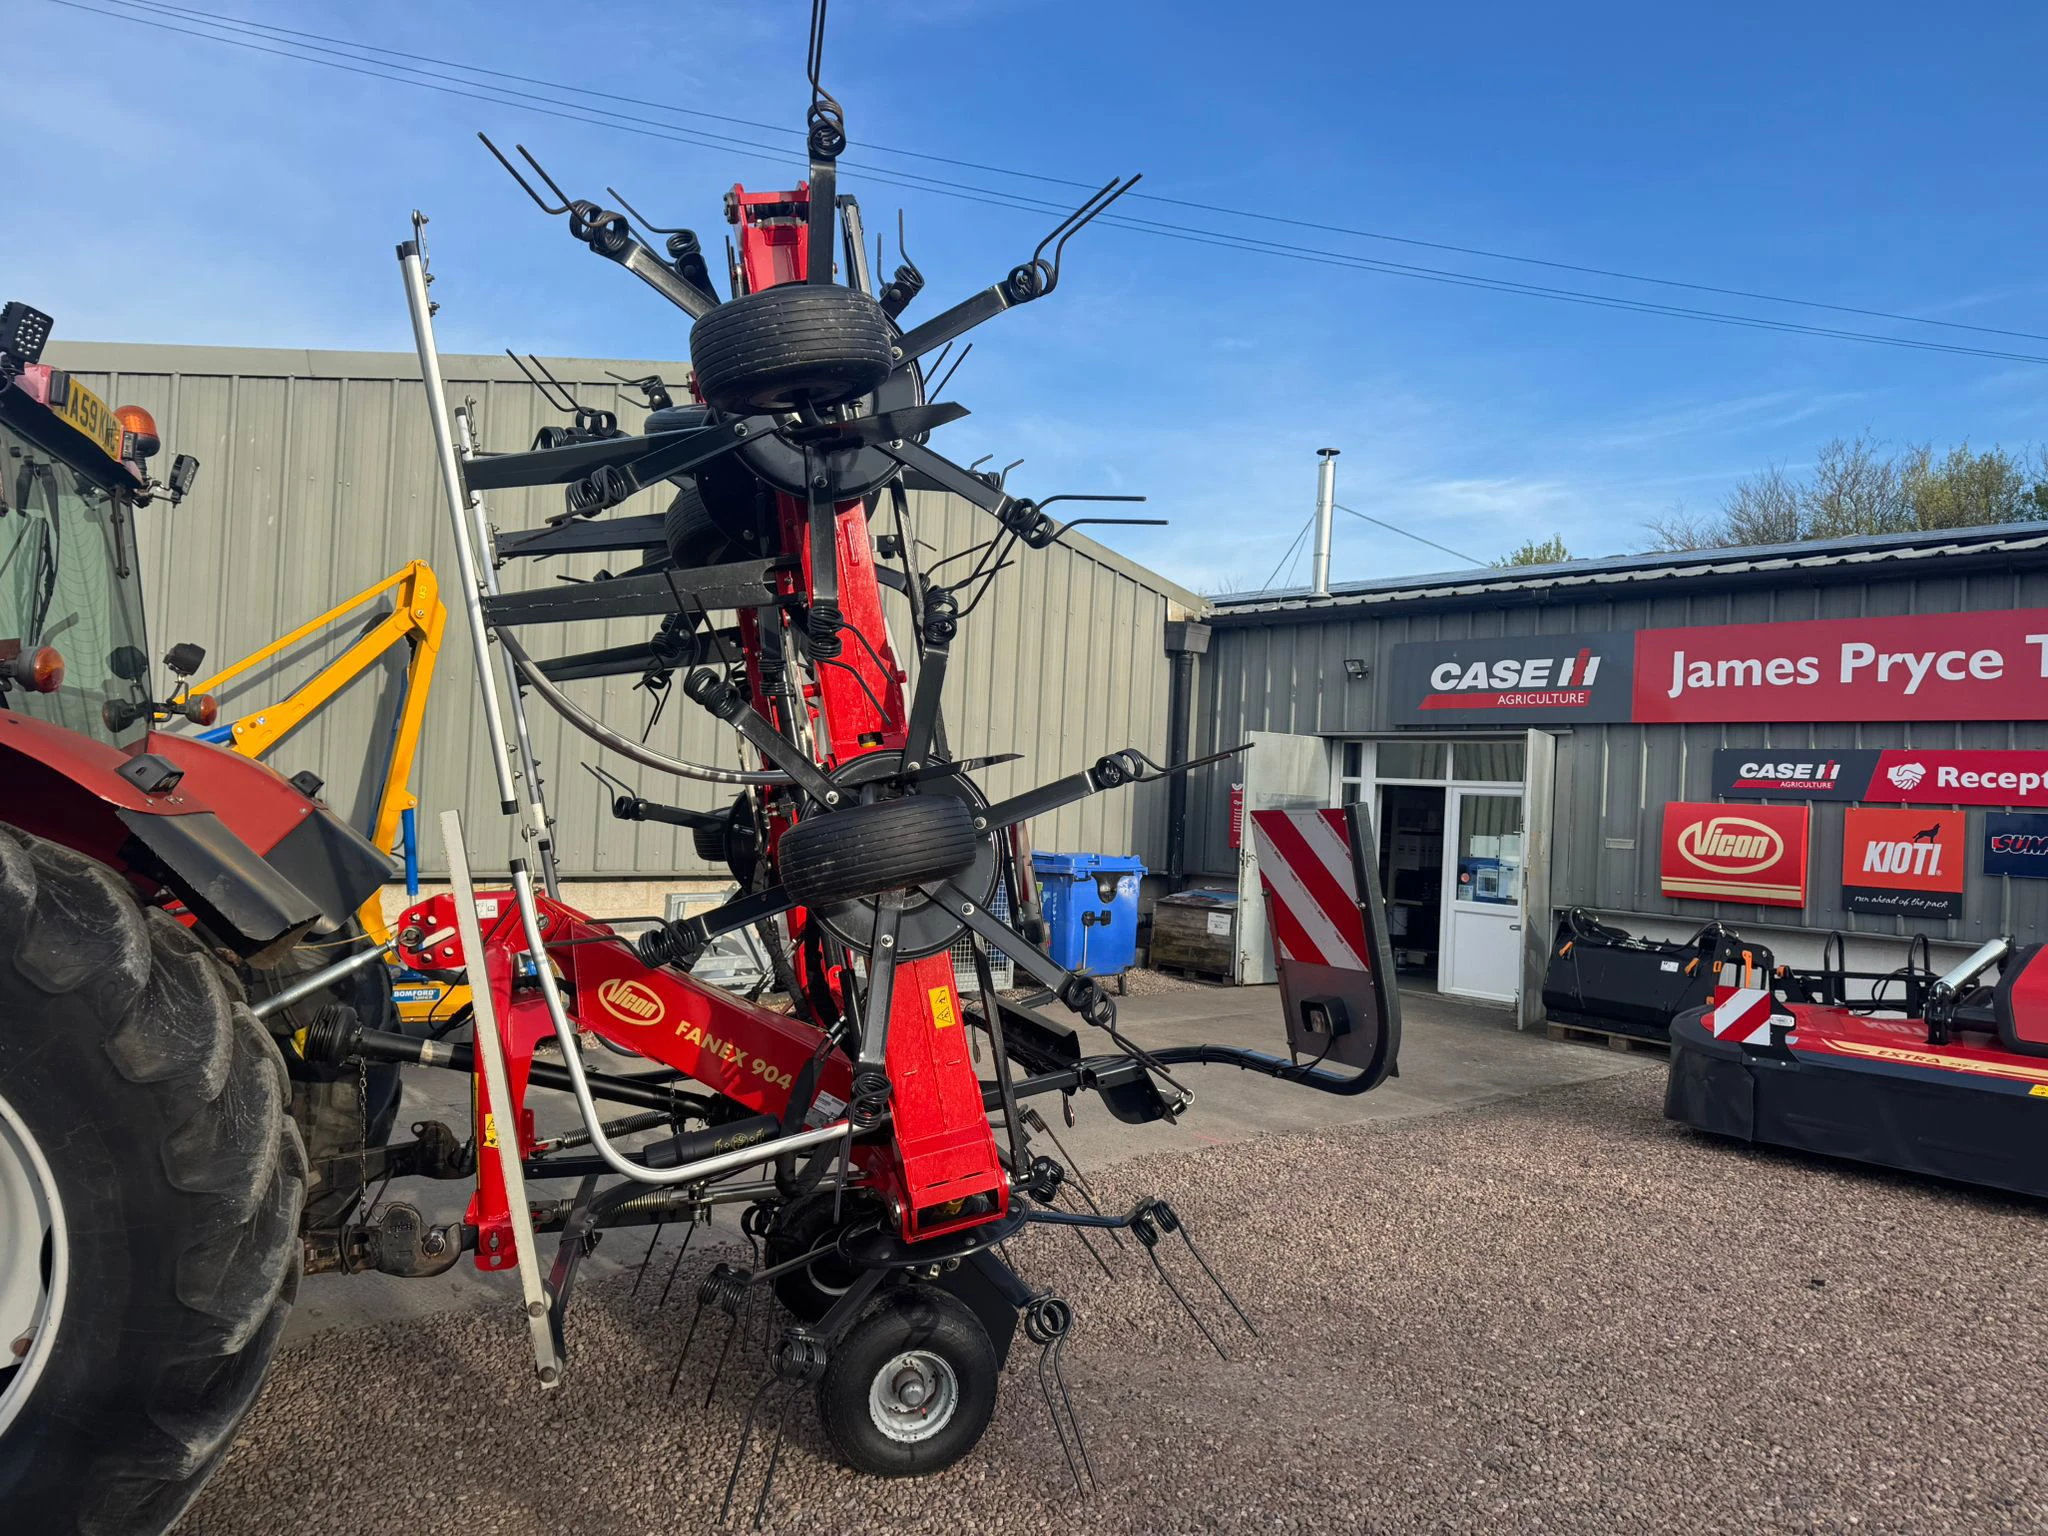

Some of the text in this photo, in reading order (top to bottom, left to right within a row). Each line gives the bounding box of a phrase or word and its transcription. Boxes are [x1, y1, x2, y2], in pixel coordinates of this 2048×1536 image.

[1430, 658, 1554, 691] CASE
[1667, 650, 1820, 699] James
[1839, 642, 2005, 695] Pryce
[1497, 692, 1586, 706] AGRICULTURE
[1739, 762, 1814, 780] CASE
[1779, 780, 1834, 790] AGRICULTURE
[1693, 821, 1770, 860] Vicon
[1862, 840, 1943, 877] KIOTI
[1854, 895, 1949, 910] run ahead of the pack
[393, 989, 435, 998] BOMFORD
[606, 981, 659, 1019] Vicon
[675, 1019, 793, 1091] FANEX 904
[1876, 1050, 1942, 1065] EXTRA
